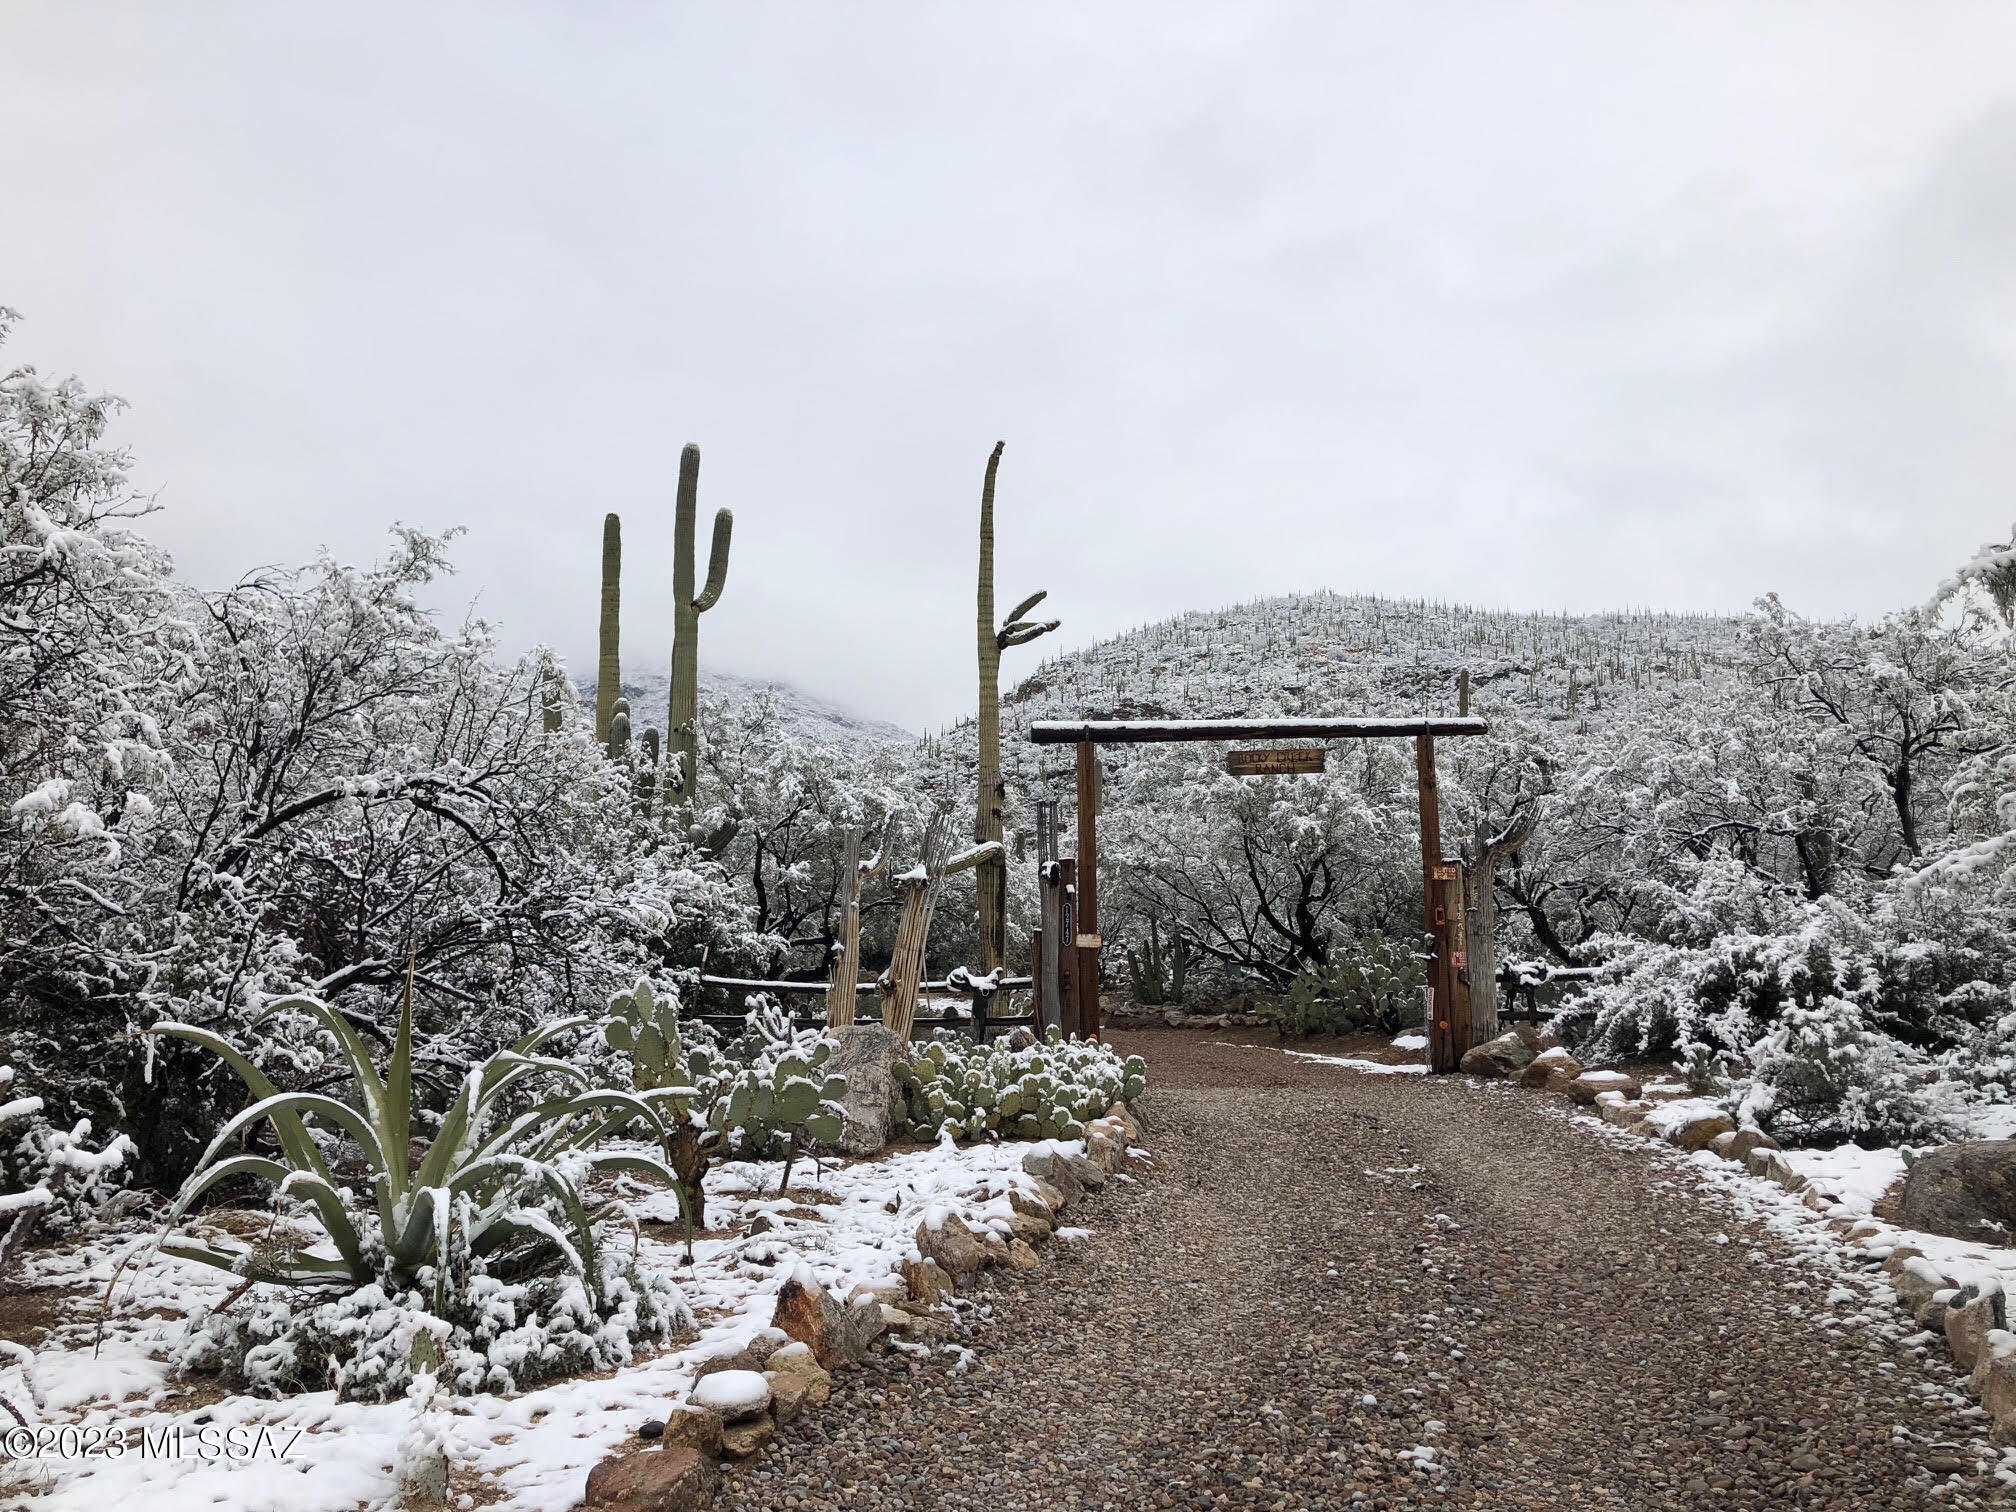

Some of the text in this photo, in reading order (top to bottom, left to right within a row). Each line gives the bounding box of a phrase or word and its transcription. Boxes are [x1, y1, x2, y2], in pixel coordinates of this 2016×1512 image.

[1239, 751, 1312, 764] ROCKY CREEK
[1255, 763, 1295, 774] RANCH
